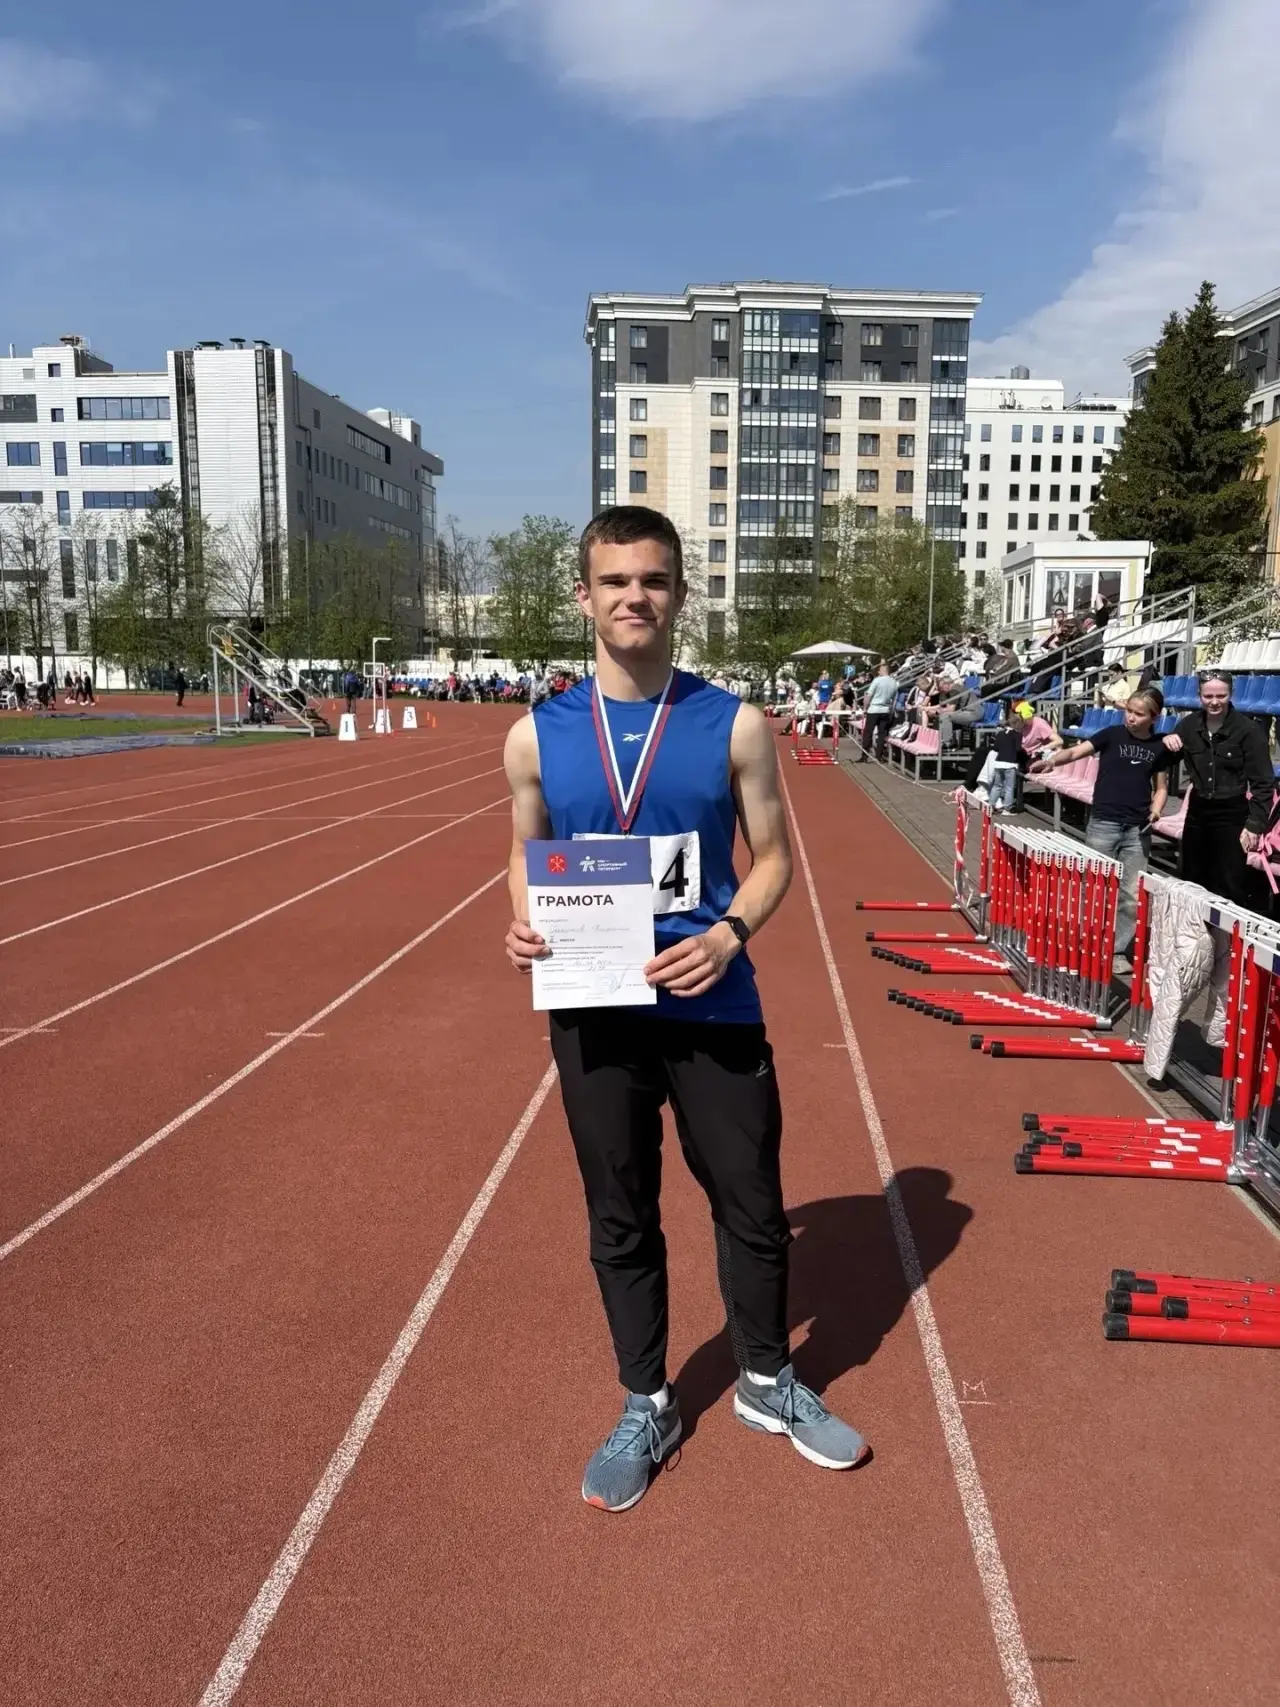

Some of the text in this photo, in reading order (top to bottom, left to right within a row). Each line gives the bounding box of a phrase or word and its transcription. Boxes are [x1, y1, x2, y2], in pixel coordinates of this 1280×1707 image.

[406, 711, 414, 722] 3
[344, 720, 349, 733] 1
[659, 847, 689, 898] 4
[537, 894, 614, 907] ГРАМОТА
